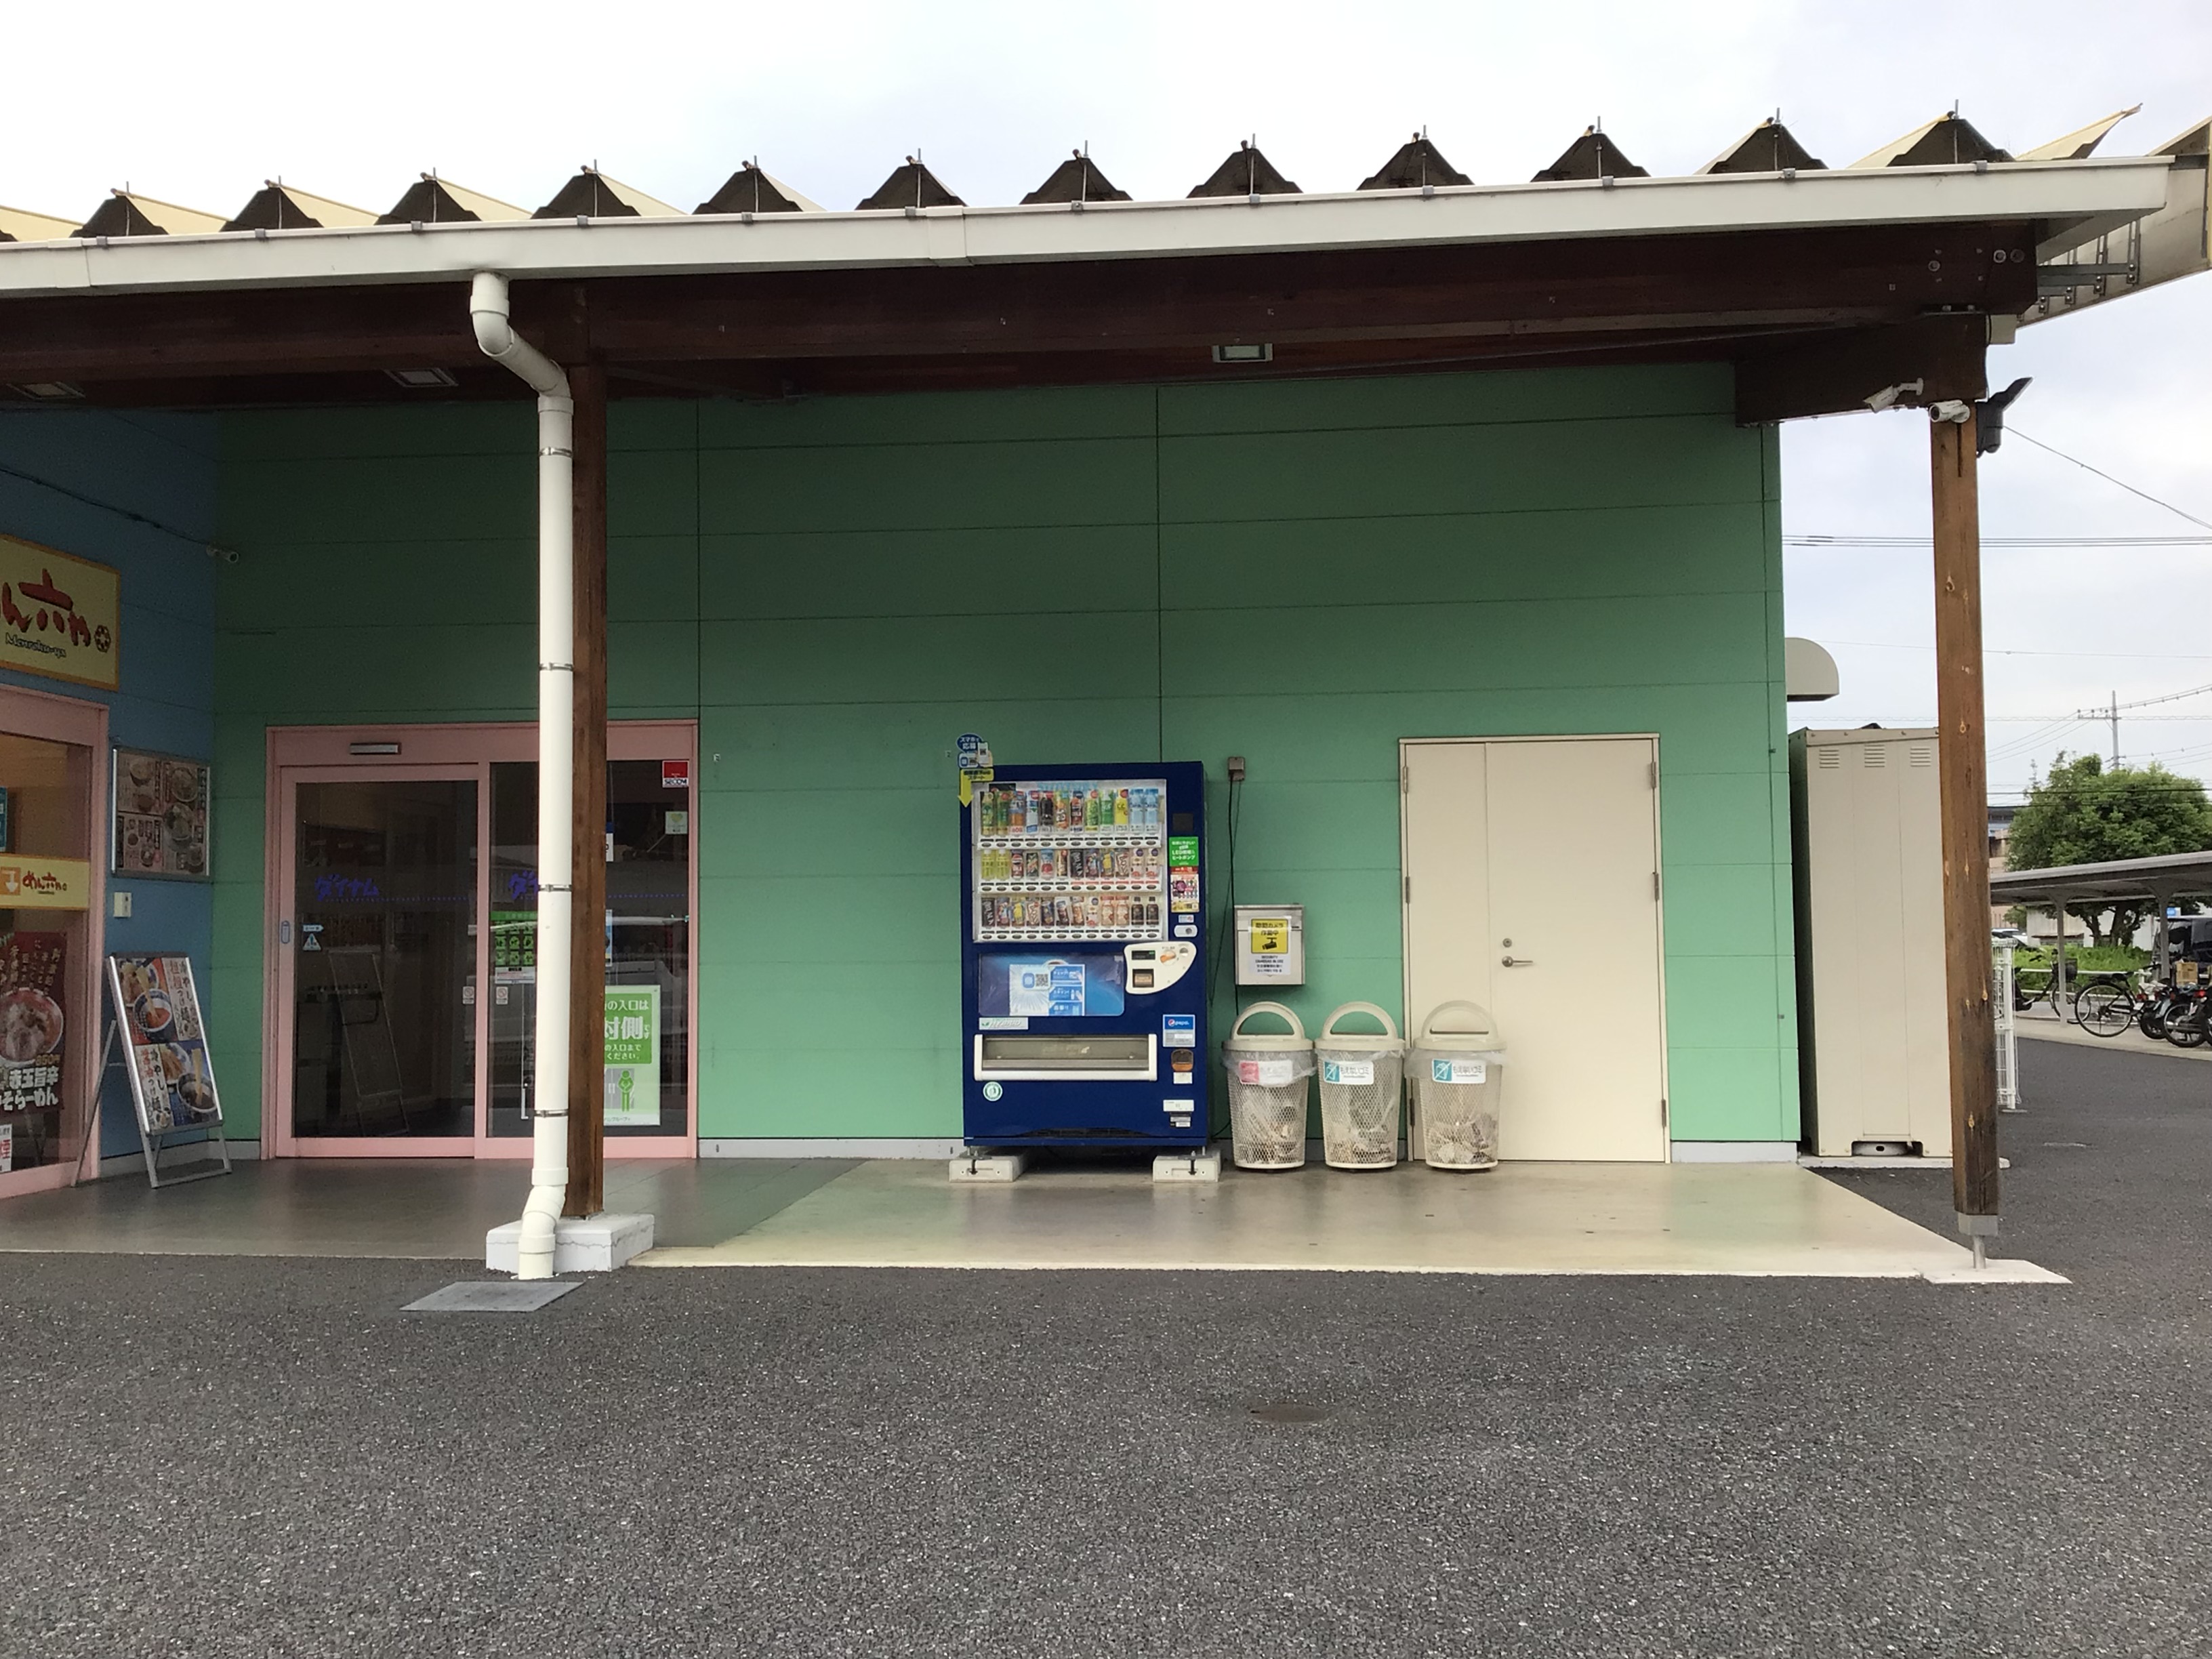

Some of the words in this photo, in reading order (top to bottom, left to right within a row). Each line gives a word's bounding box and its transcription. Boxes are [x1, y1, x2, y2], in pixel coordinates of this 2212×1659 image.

[0, 568, 91, 647] ん六や
[605, 1000, 649, 1011] の入口は
[605, 1044, 642, 1052] の入口まで
[9, 1065, 60, 1090] 赤玉旨辛
[0, 1087, 59, 1111] そらーめん
